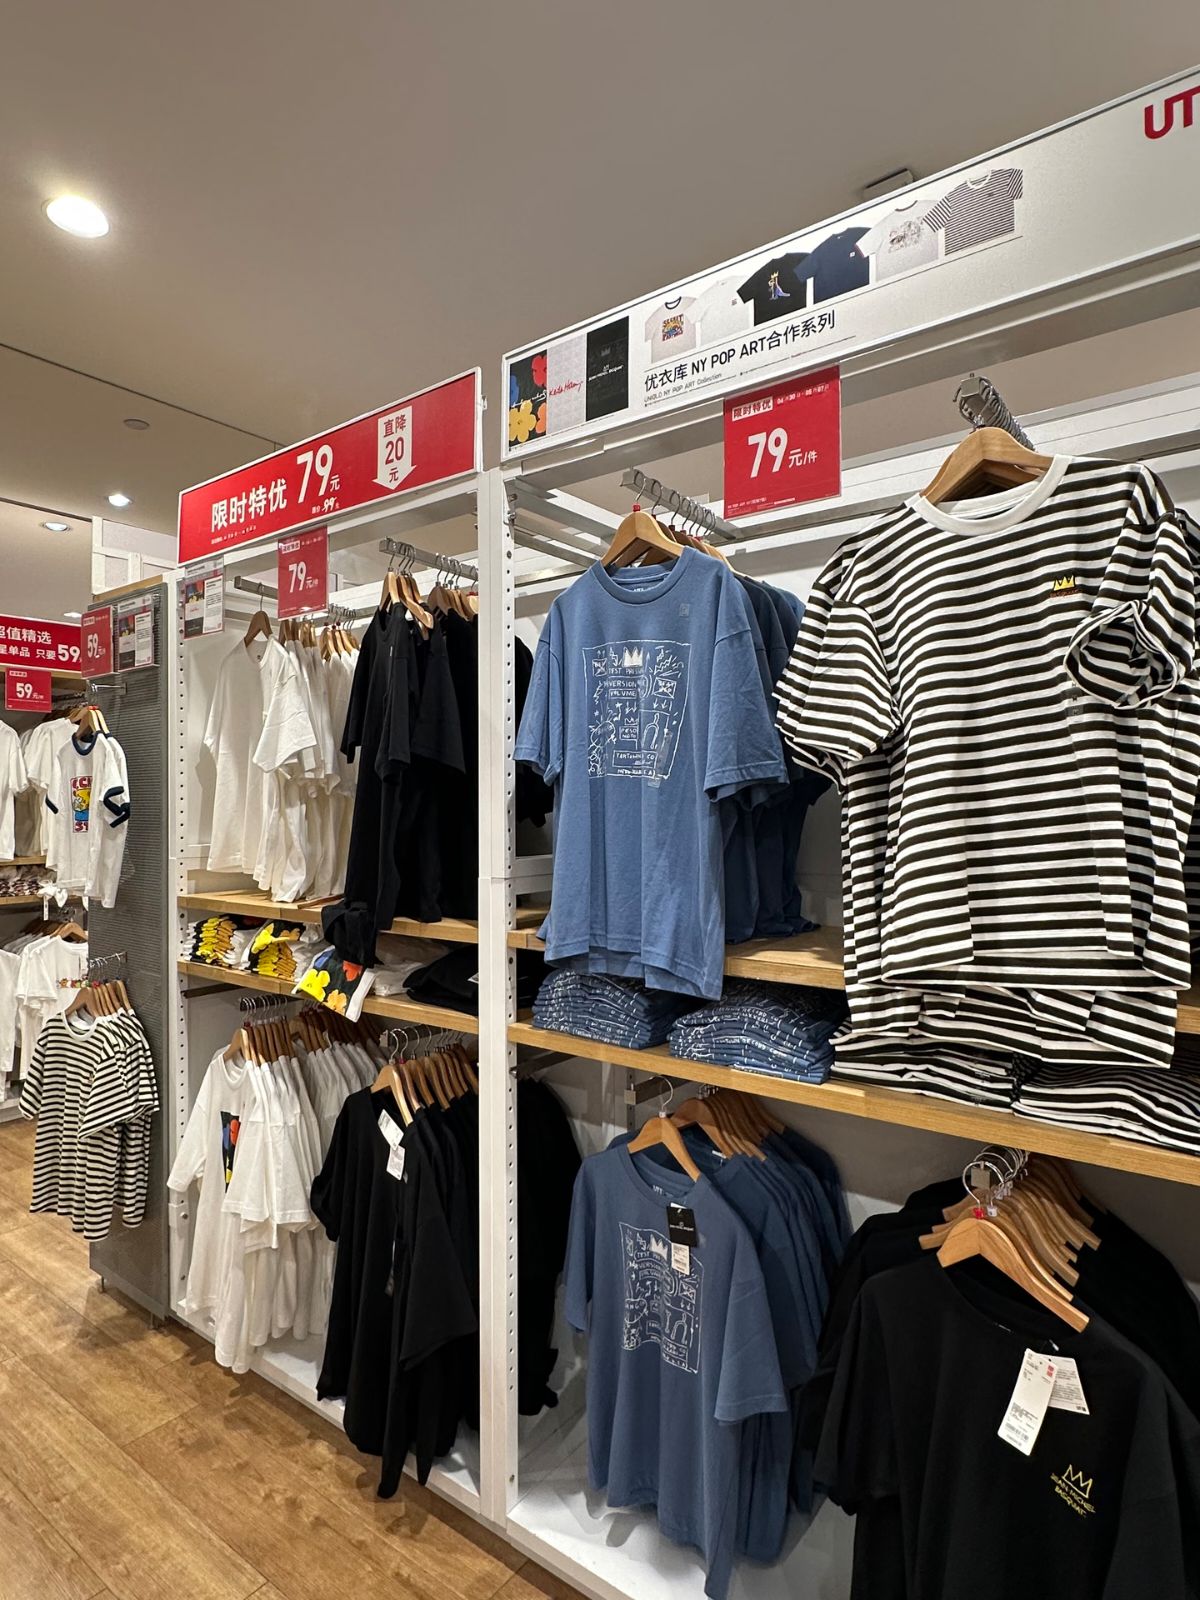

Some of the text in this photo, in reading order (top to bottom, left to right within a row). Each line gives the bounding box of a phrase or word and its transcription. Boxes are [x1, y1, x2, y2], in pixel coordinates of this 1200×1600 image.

[1144, 85, 1200, 140] UT
[644, 363, 688, 393] 优衣库
[691, 357, 708, 376] NY
[711, 349, 736, 368] POP
[739, 309, 836, 360] ART合作系列
[383, 413, 407, 438] 直降
[385, 437, 405, 466] 20
[388, 467, 400, 484] 元
[211, 477, 288, 534] 限时特优
